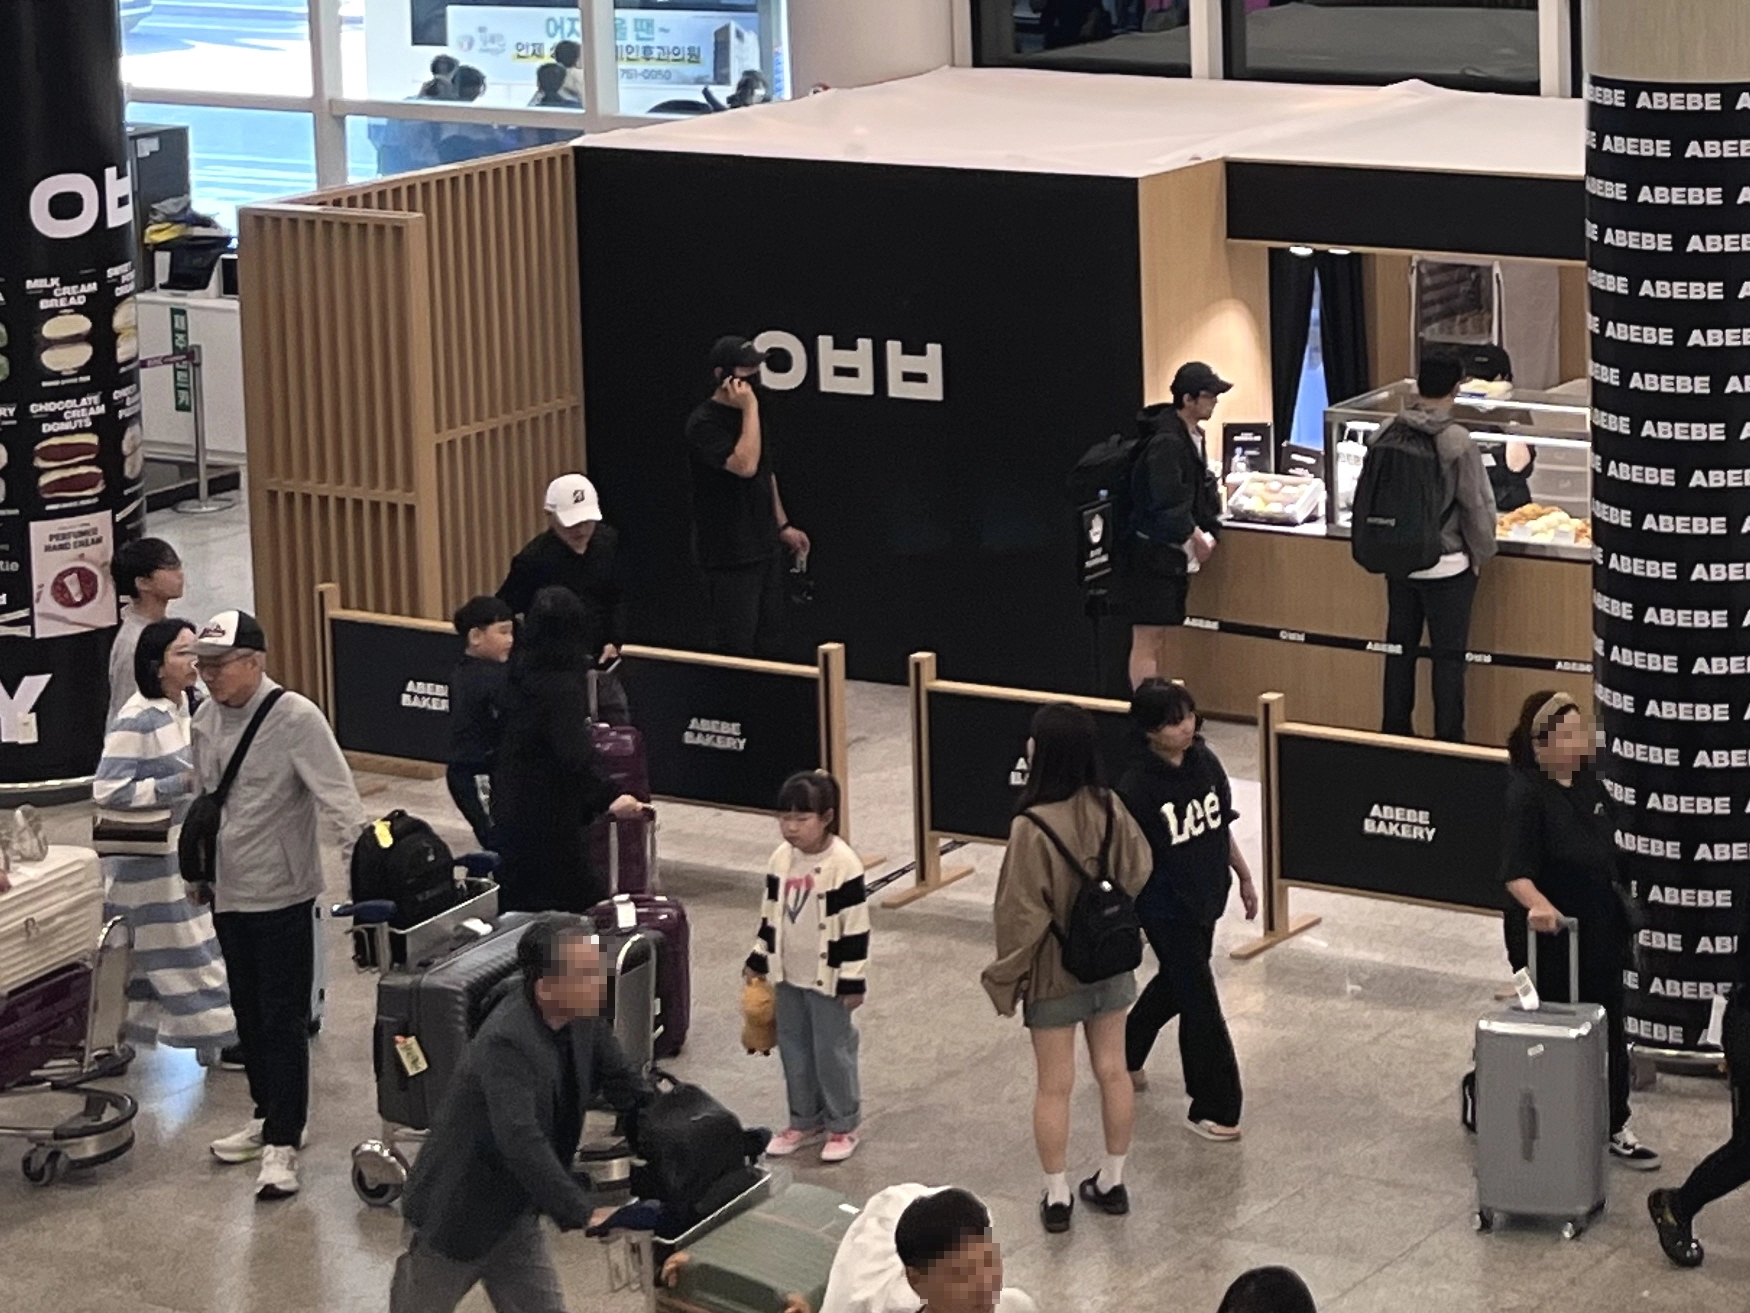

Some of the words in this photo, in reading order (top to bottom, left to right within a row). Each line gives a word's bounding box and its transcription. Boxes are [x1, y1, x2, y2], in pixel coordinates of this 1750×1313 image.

[1587, 86, 1626, 108] BEBE
[1636, 92, 1721, 110] ABEBE
[1602, 135, 1671, 157] ABEBE
[1638, 186, 1723, 205] ABEBE
[1604, 228, 1672, 251] ABEBE
[26, 277, 60, 289] MILK
[53, 282, 98, 297] CREAM
[1588, 268, 1628, 294] BEBE
[1639, 280, 1723, 299] ABEBE
[39, 295, 86, 310] BREAD
[1605, 321, 1673, 345] ABEBE
[1629, 372, 1710, 393] ABEBE
[29, 394, 102, 414] CHOCOLATE
[63, 404, 106, 421] CREAM
[41, 418, 92, 433] DONUTS
[1641, 420, 1725, 440] ABEBE
[1607, 461, 1675, 486] ABEBE
[1642, 514, 1727, 534] ABEBE
[1609, 553, 1677, 579] ABEBE
[1644, 607, 1728, 628] ABEBE
[1184, 617, 1219, 630] ABEBE
[1366, 641, 1403, 654] ABEBE
[1610, 646, 1678, 673] ABEBE
[402, 693, 449, 711] BAKER
[1645, 700, 1729, 721] ABEBE
[689, 718, 741, 736] ABEBE
[684, 731, 747, 751] BAKERY
[1612, 738, 1679, 765] ABEBE
[1370, 804, 1431, 823] ABEBE
[1647, 793, 1730, 814] ABEBE
[1160, 787, 1222, 846] Lee
[1364, 818, 1437, 841] BAKERY
[1615, 830, 1680, 859] ABEBE
[1648, 885, 1732, 907] ABEBE
[1638, 930, 1682, 952] EBE
